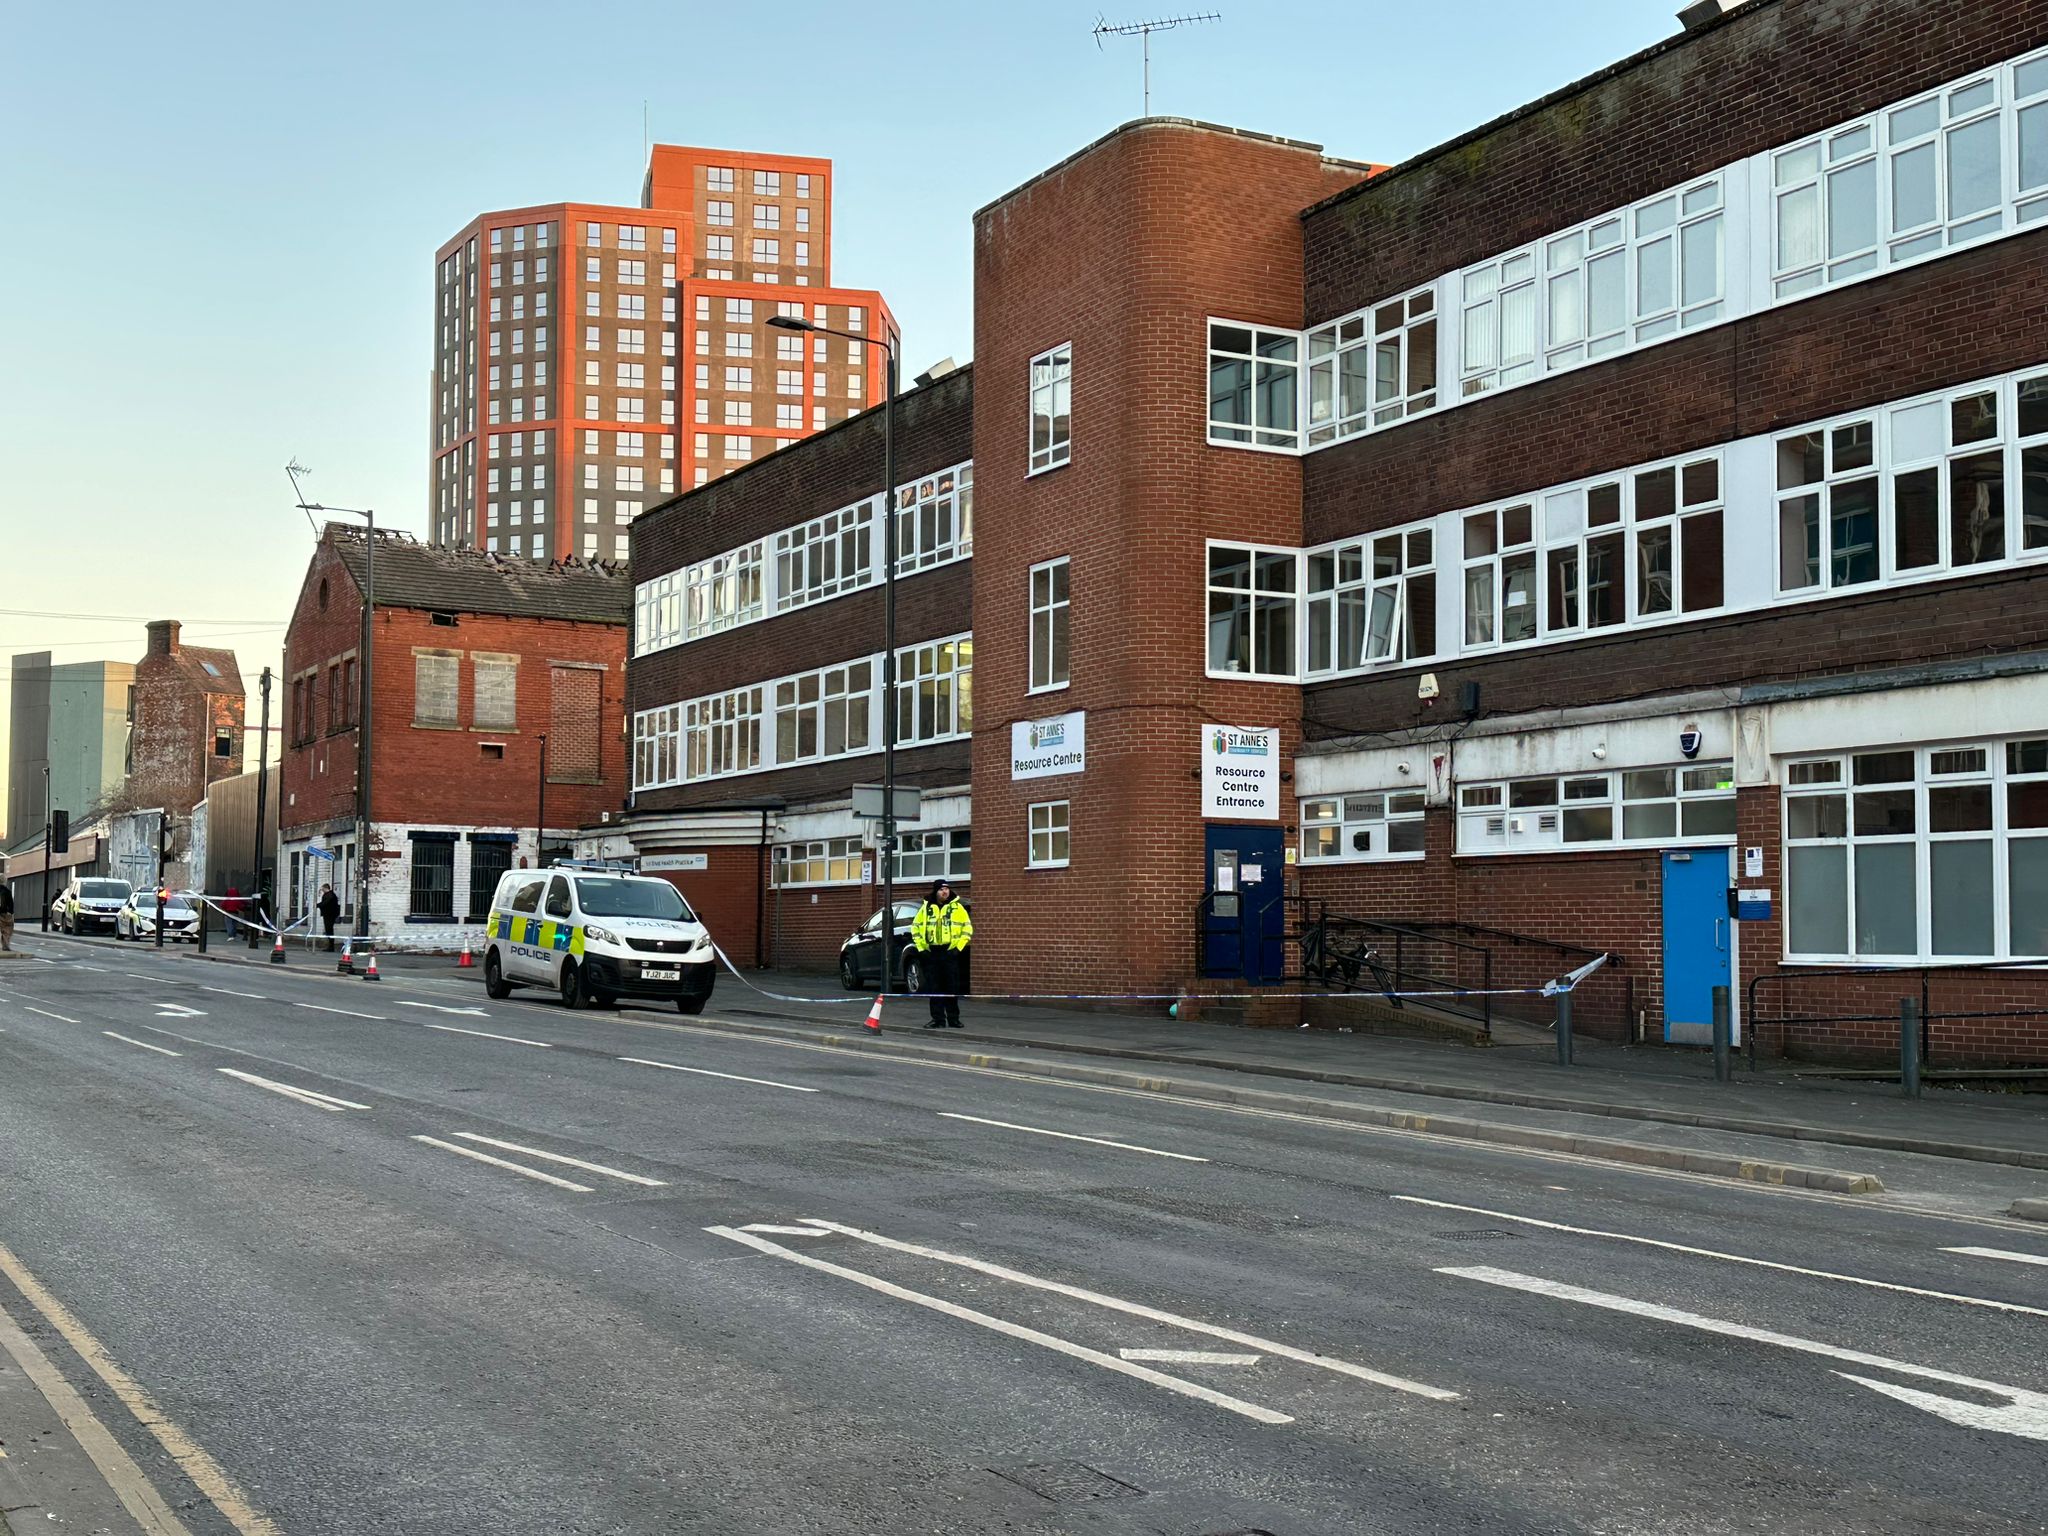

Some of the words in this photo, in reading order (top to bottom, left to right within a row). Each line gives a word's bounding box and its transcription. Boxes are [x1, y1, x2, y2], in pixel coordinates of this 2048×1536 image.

[1039, 726, 1046, 738] ST
[1046, 723, 1064, 737] ANNE'S
[1228, 734, 1238, 746] ST
[1240, 735, 1268, 747] ANNE'S
[1014, 757, 1052, 772] Resource
[1053, 752, 1082, 766] Centre
[1216, 766, 1265, 778] Resource
[1222, 781, 1259, 793] Centre
[1216, 796, 1265, 808] Entrance
[625, 920, 682, 930] POLICE
[511, 945, 551, 962] POLICE
[646, 970, 661, 979] YJ21
